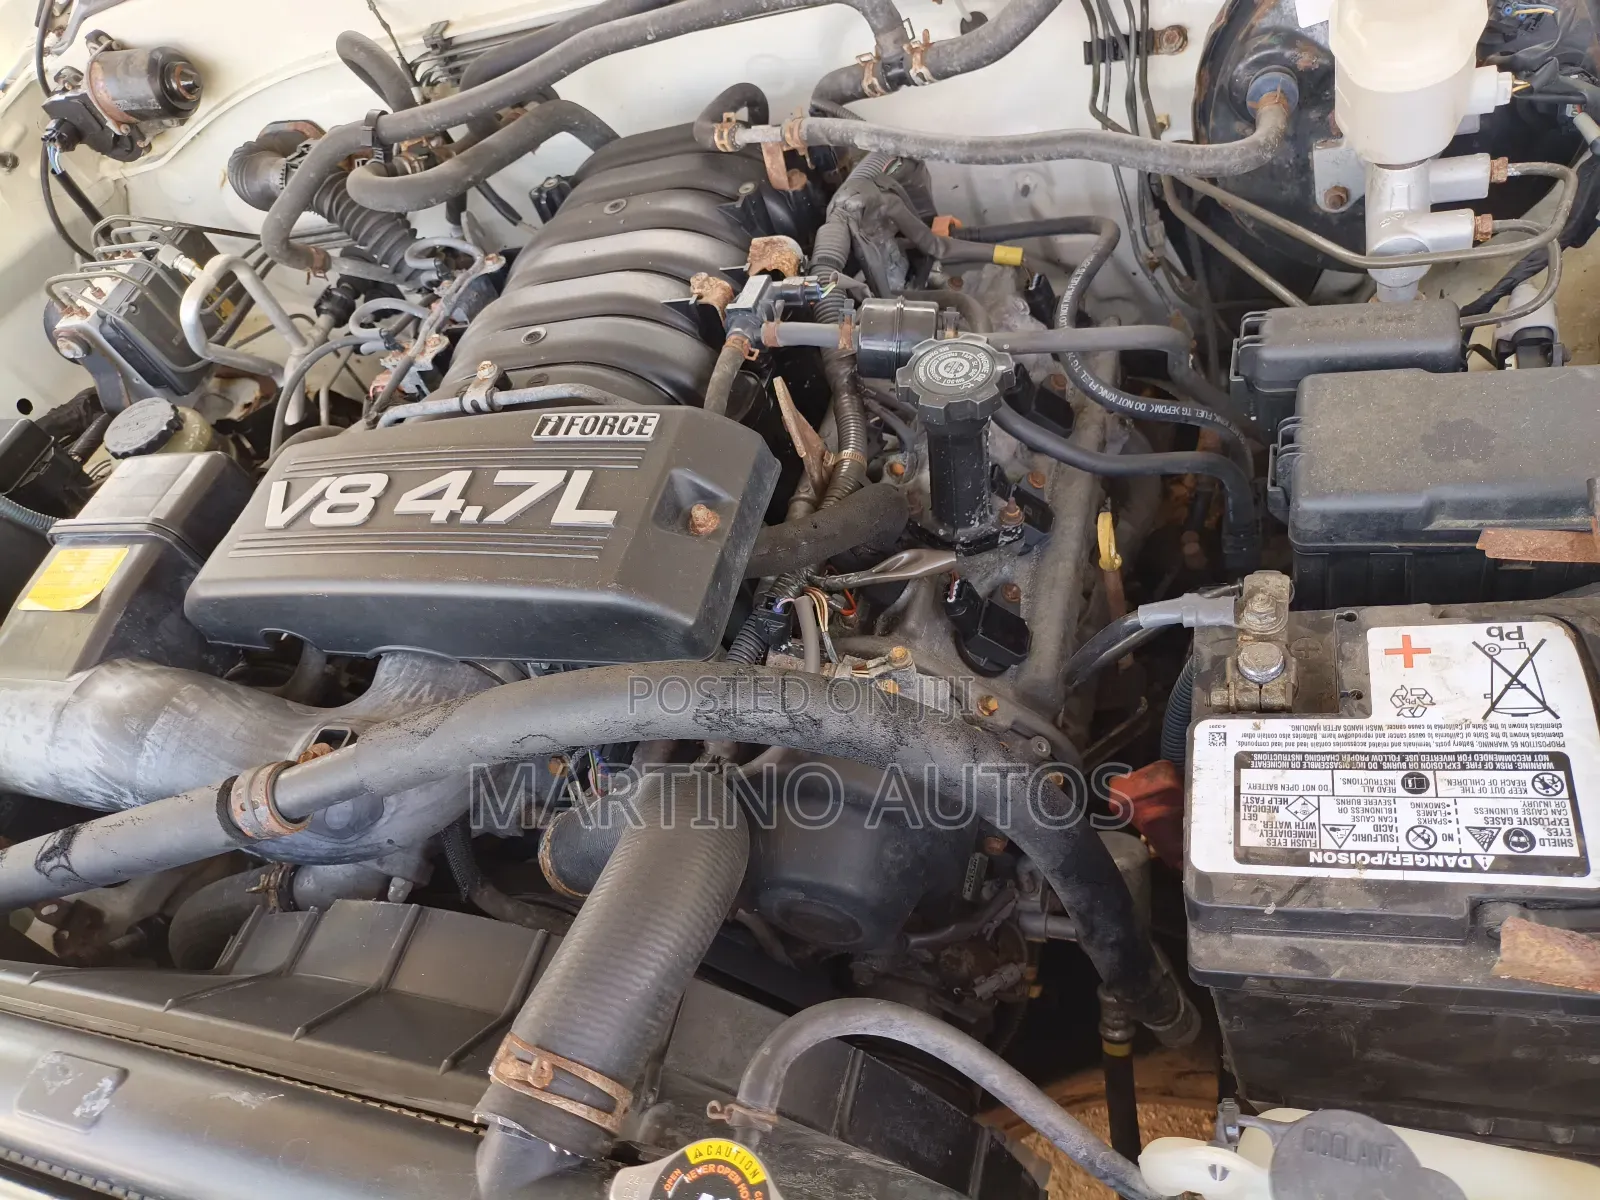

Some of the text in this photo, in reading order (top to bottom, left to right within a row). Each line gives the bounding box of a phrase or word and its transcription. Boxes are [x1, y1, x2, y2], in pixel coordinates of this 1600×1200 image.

[977, 352, 990, 373] ENGINE
[1117, 396, 1134, 408] NOT
[1134, 402, 1146, 412] DO
[1181, 407, 1192, 416] TG
[1194, 408, 1212, 420] FUEL
[266, 470, 618, 530] V8 4.7L
[1486, 626, 1524, 641] Pb
[1249, 761, 1289, 769] INCINERATE.
[1260, 821, 1291, 829] WATER.
[1484, 816, 1569, 826] EXPLOSIVE GASES
[1260, 829, 1316, 838] IMMEDIATELY
[1543, 827, 1571, 836] EYES.
[1266, 838, 1316, 847] FLUSH EYES
[1352, 834, 1394, 842] SULFURIC
[1442, 833, 1453, 842] NO
[1539, 838, 1573, 848] SHIELD
[1309, 851, 1472, 868] DANGER/POISON
[1304, 1128, 1398, 1173] COOLANT
[706, 1145, 760, 1179] CAUTION
[664, 1168, 682, 1192] OPEN
[684, 1164, 716, 1183] NEVER
[717, 1164, 742, 1187] OPEN
[738, 1183, 751, 1200] HO
